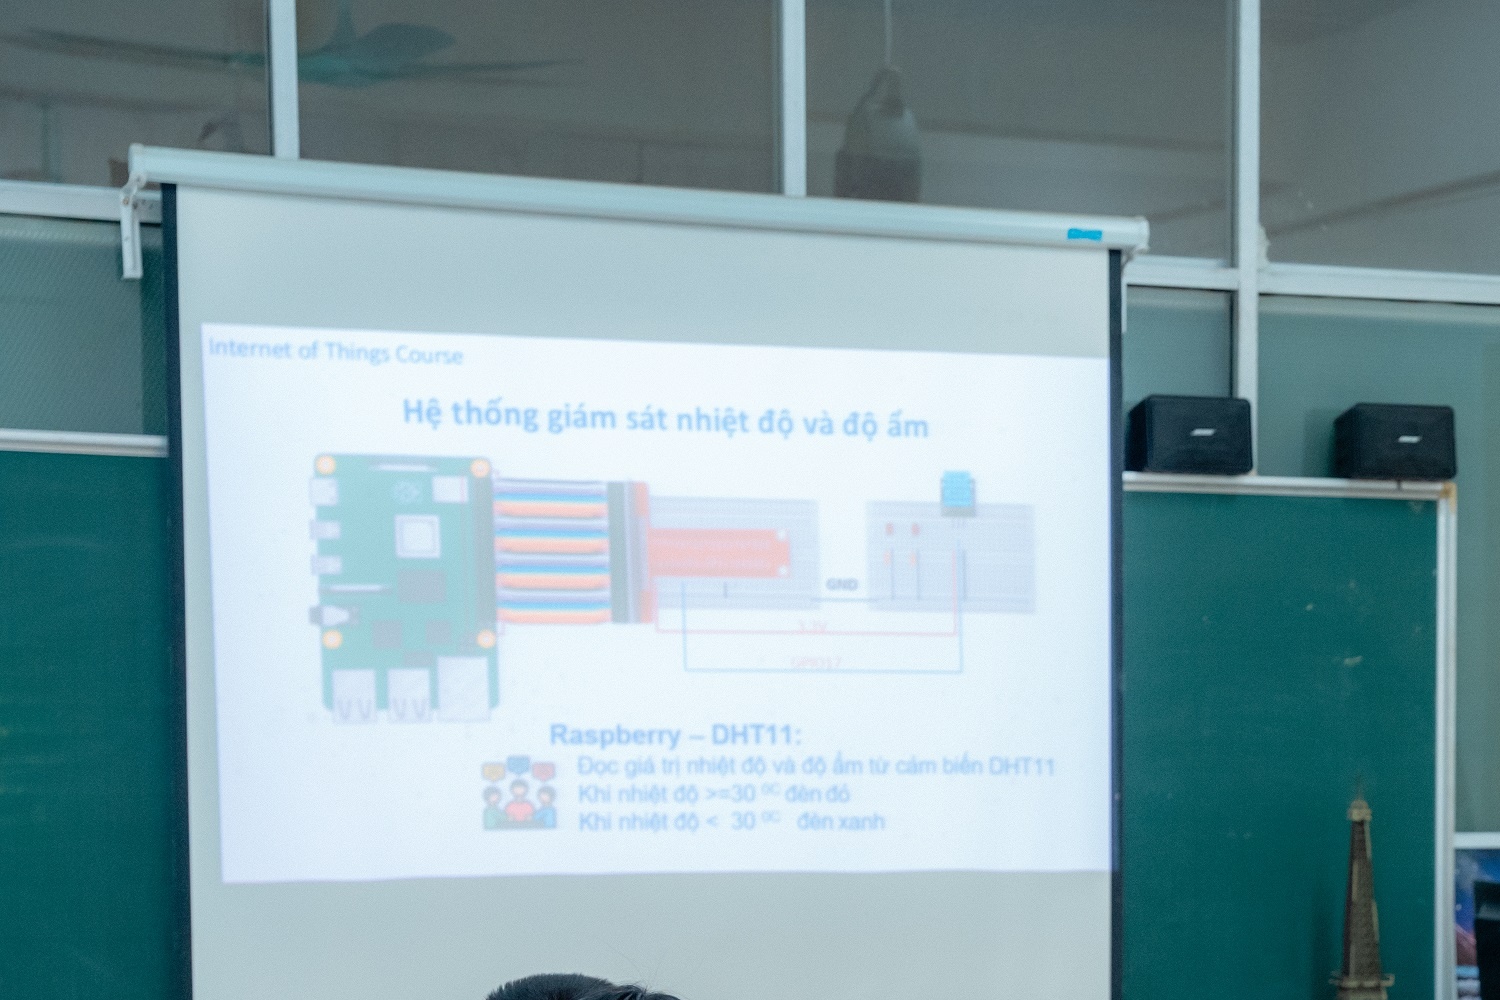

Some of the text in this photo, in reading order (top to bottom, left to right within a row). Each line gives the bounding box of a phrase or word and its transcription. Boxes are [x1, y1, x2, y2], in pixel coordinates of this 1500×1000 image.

[208, 336, 464, 367] Internet of Things Course
[402, 397, 442, 431] Hệ
[451, 396, 539, 433] thống
[547, 402, 617, 434] giám
[626, 403, 668, 431] sát
[676, 406, 749, 438] nhiệt
[757, 408, 793, 439] độ
[803, 410, 834, 435] và
[842, 411, 878, 442] độ
[550, 723, 680, 750] Raspberry
[712, 723, 801, 746] DHT11:
[989, 755, 1055, 776] DHT11
[578, 784, 611, 803] Khi
[578, 811, 611, 831] Khi
[731, 811, 756, 831] 30
[838, 811, 885, 831] xanh
